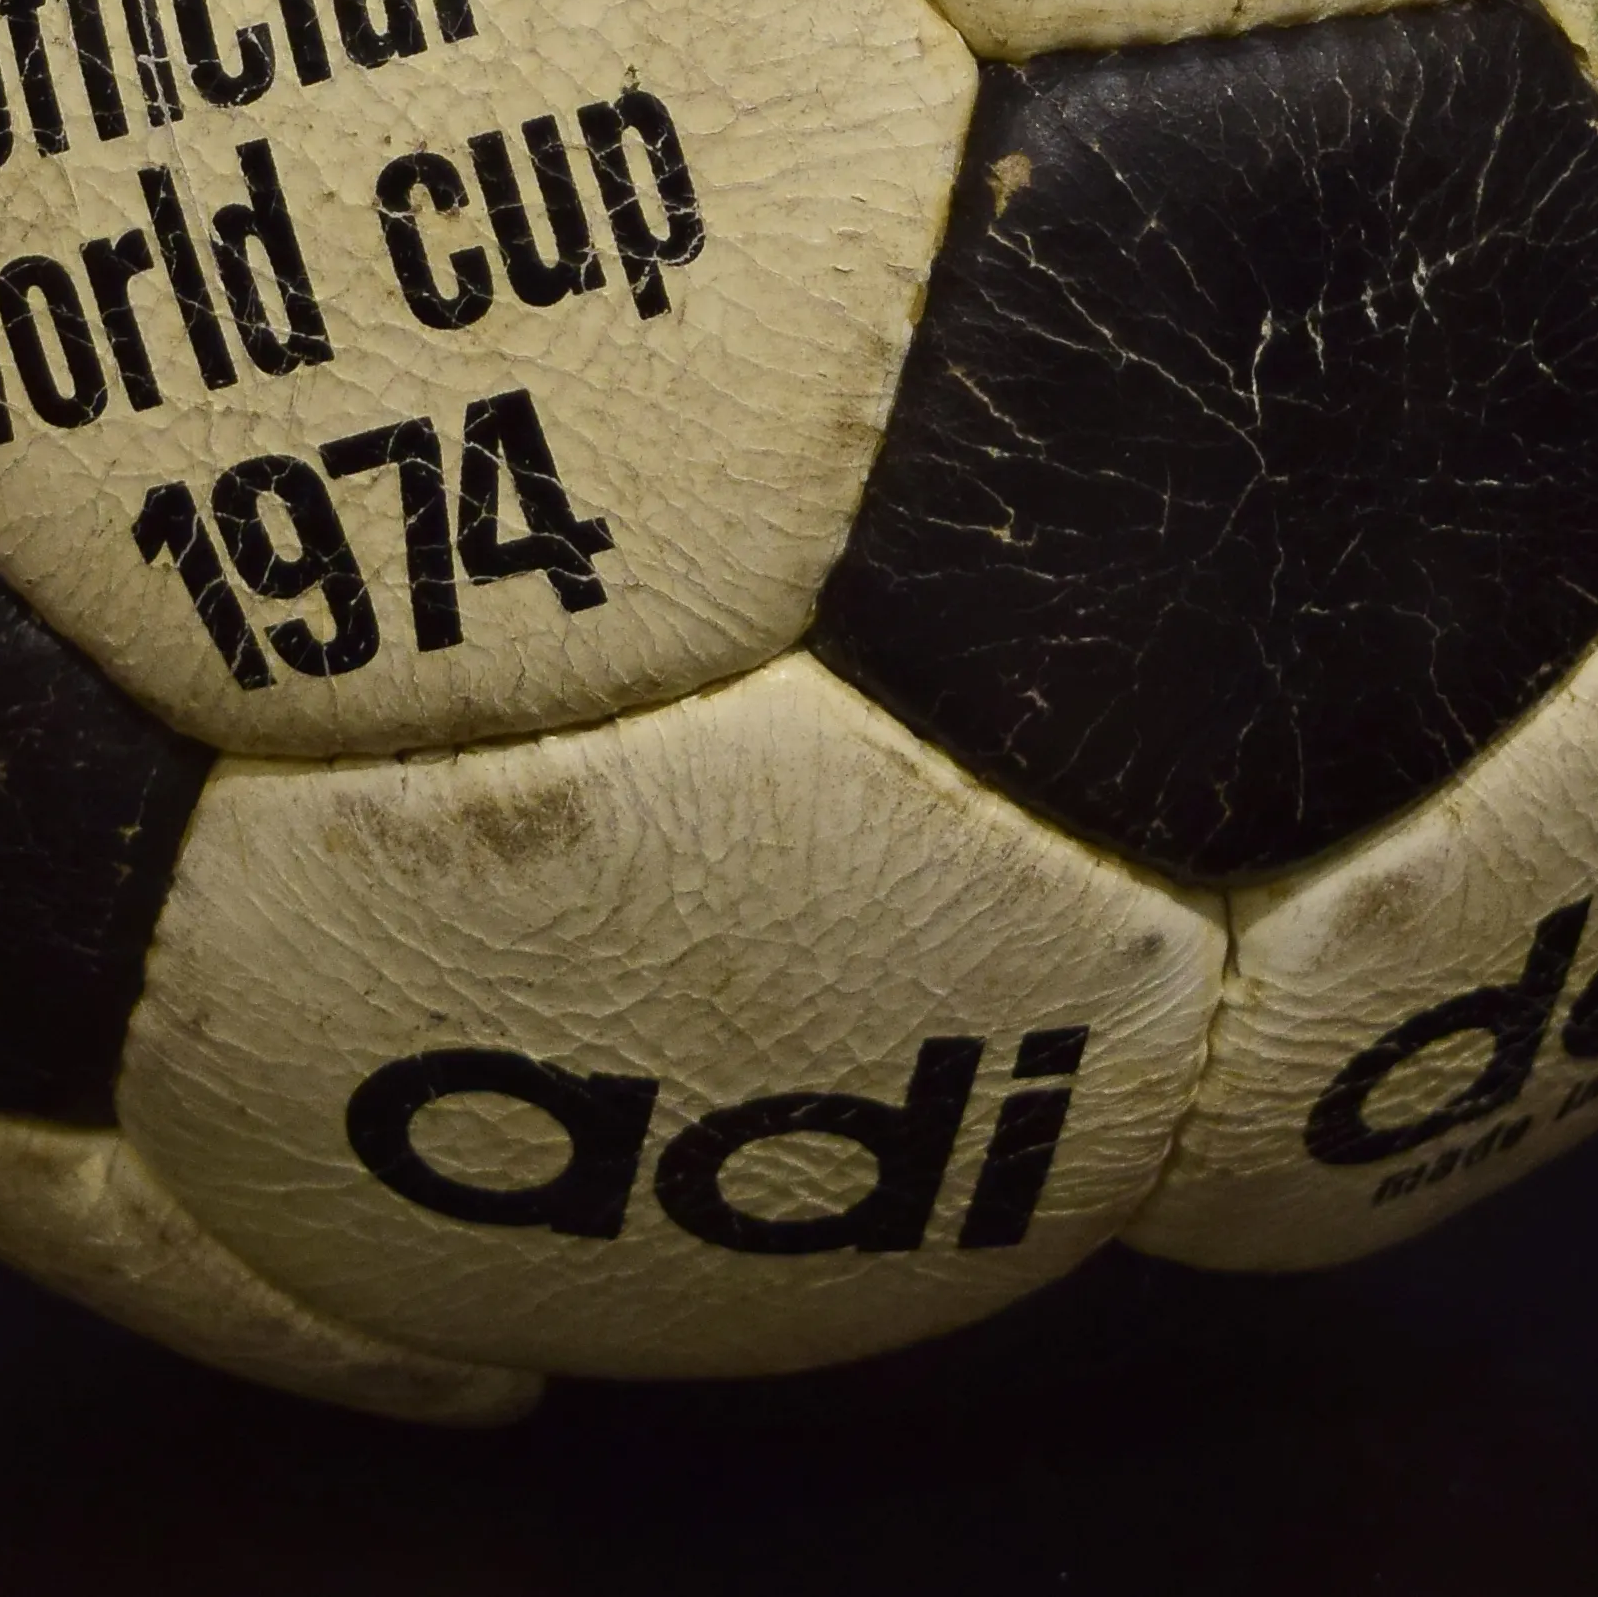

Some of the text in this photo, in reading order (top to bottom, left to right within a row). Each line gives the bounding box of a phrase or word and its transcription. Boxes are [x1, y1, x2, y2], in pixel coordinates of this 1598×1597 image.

[376, 89, 706, 331] cup
[131, 388, 616, 691] 1974
[345, 1024, 1090, 1255] adi
